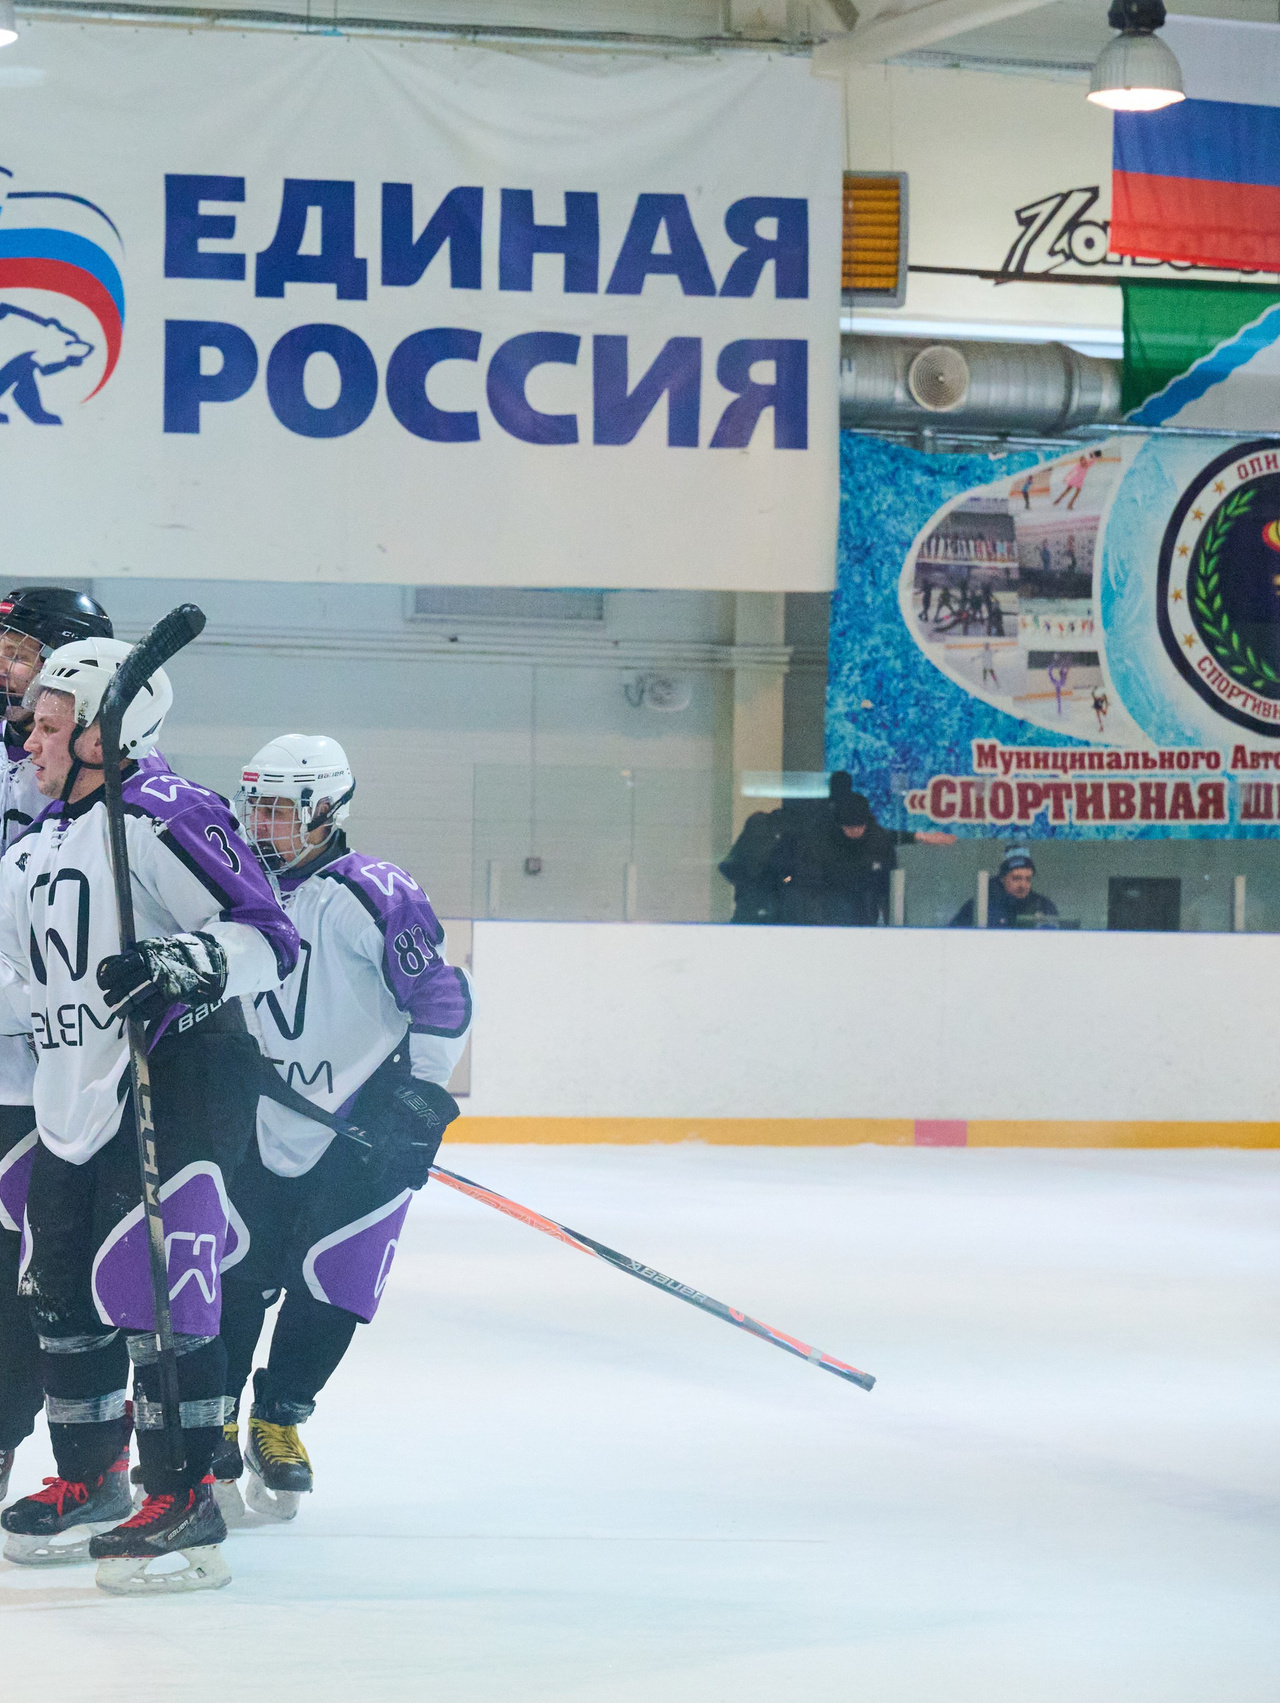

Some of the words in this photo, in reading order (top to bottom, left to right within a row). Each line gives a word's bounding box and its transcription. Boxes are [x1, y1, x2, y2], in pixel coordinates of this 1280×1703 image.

[164, 173, 809, 301] ЕДИНАЯ
[164, 319, 809, 451] РОССИЯ
[975, 744, 1220, 774] Муниципального
[908, 779, 1225, 820] «СПОРТИВНАЯ
[1239, 782, 1280, 820] Ш
[638, 1267, 708, 1303] BAUER
